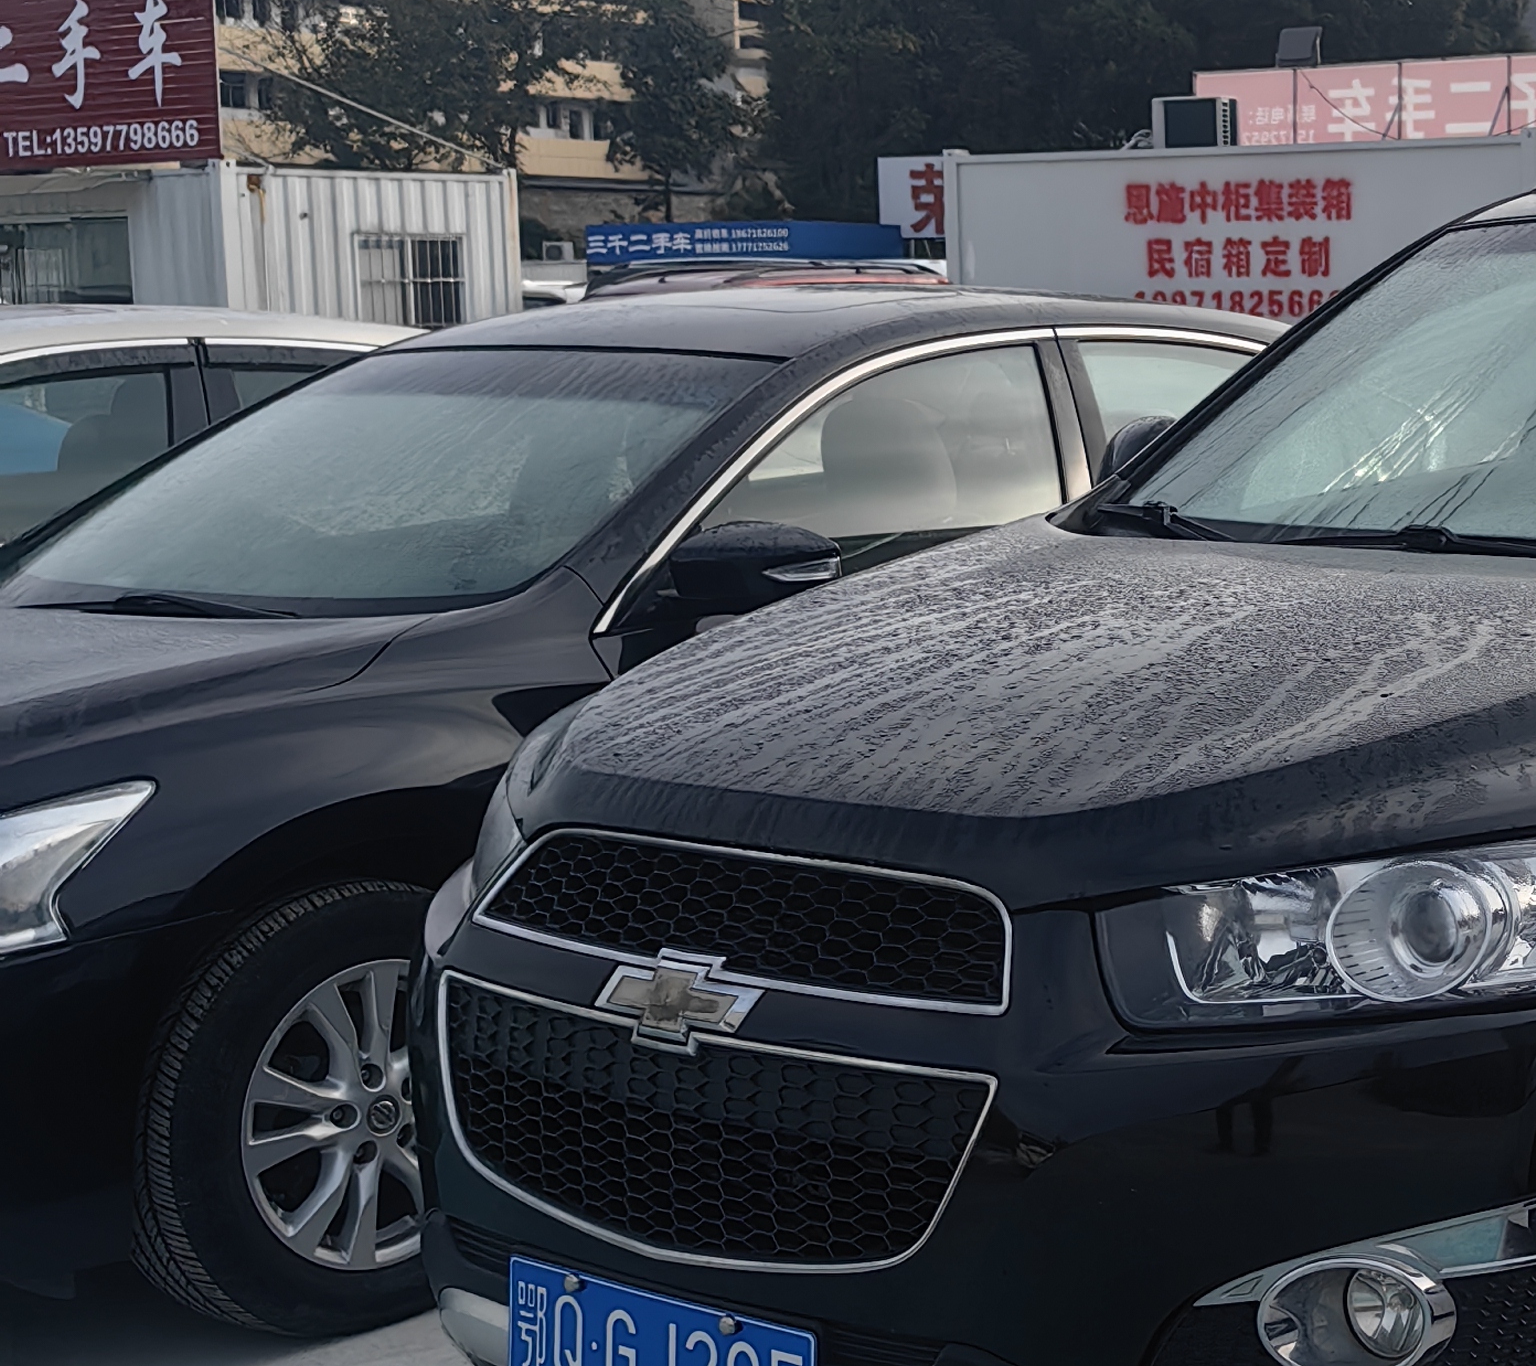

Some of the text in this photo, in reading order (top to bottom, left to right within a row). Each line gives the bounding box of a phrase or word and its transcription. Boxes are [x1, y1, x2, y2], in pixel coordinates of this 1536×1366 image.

[4, 119, 199, 158] TEL:13597798666
[1124, 178, 1353, 224] 恩施中柜集装箱
[586, 232, 693, 255] 三千二手车
[1147, 236, 1330, 278] 民宿箱定制
